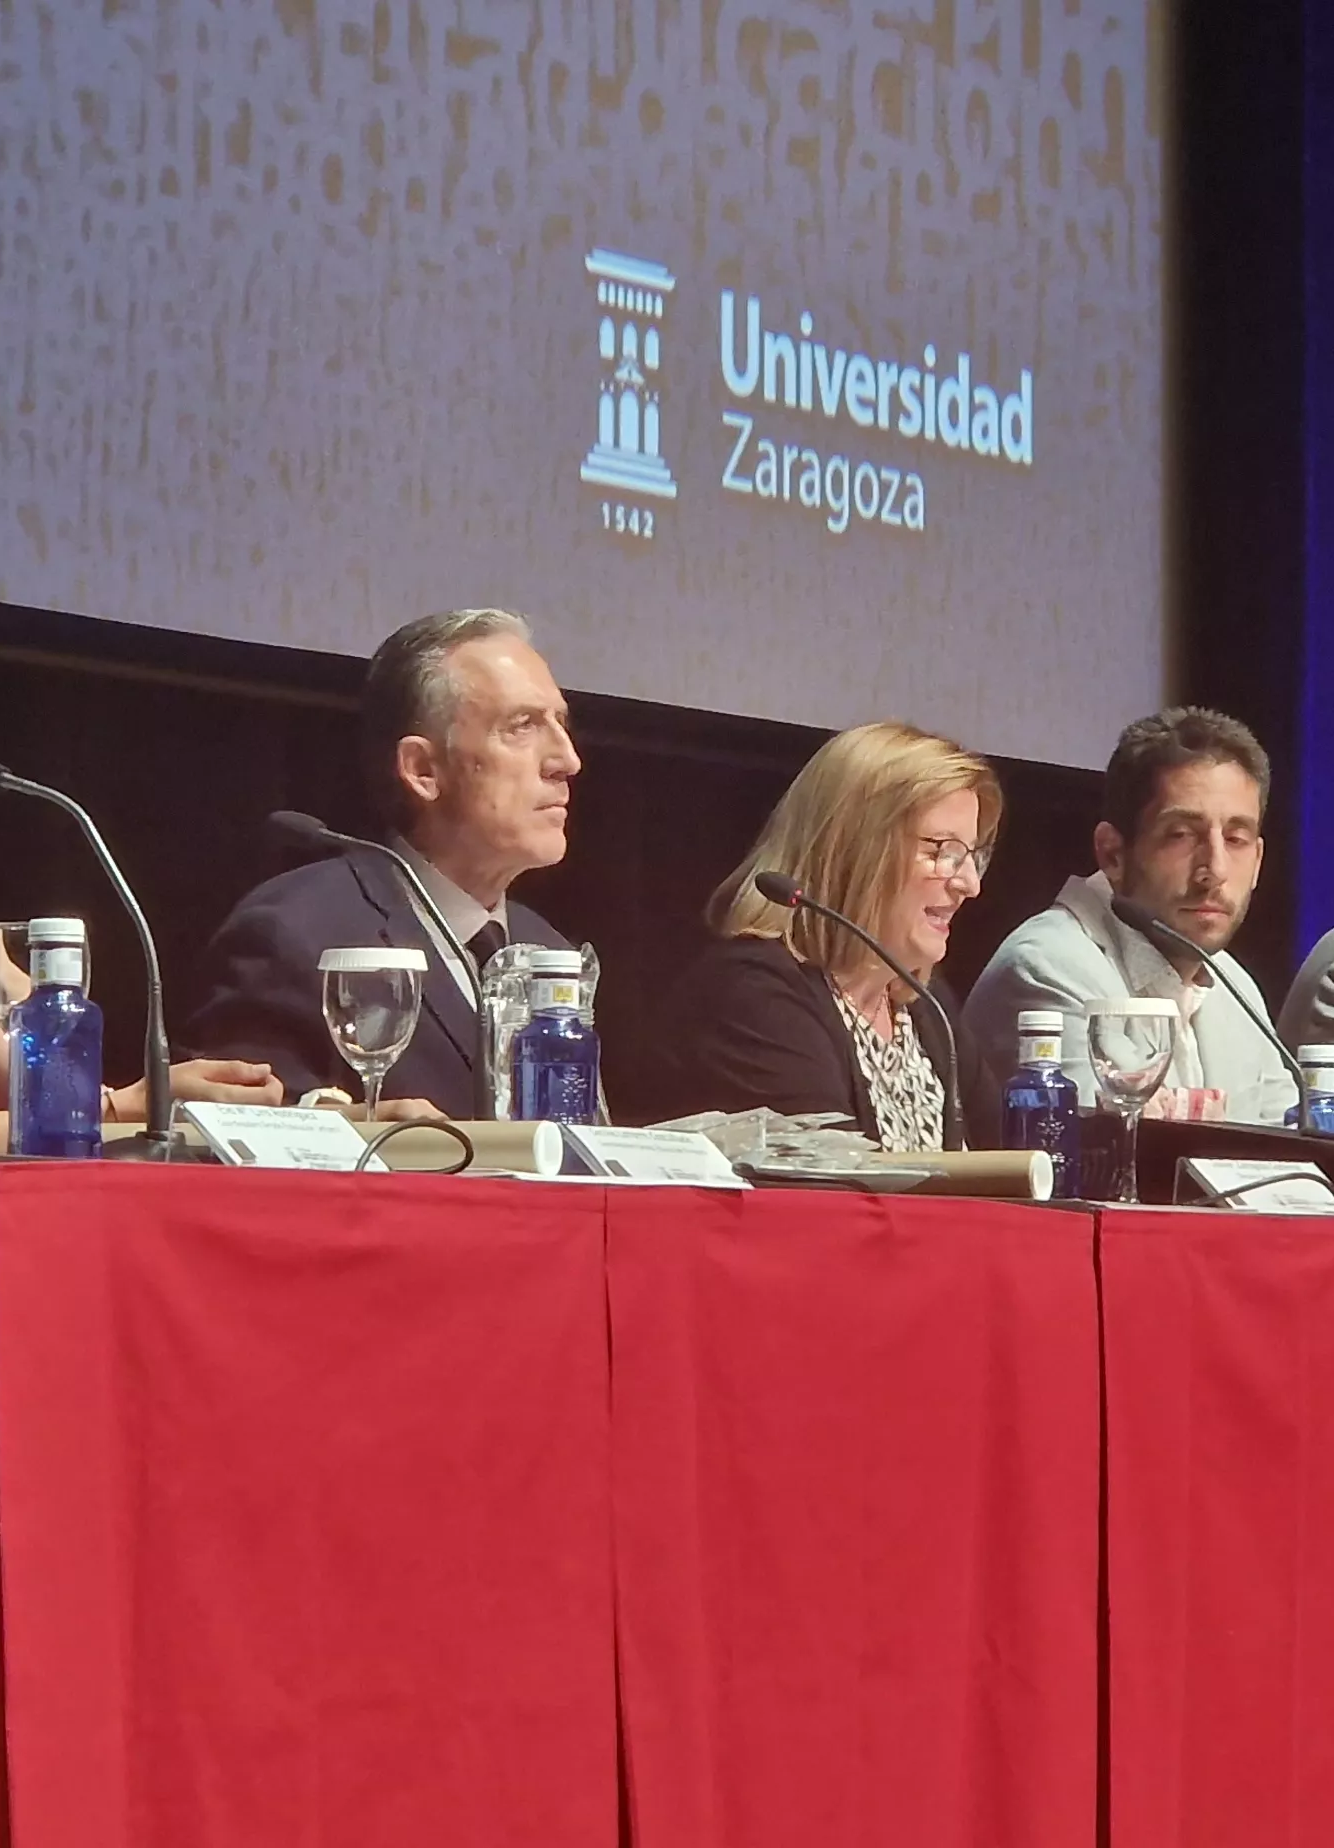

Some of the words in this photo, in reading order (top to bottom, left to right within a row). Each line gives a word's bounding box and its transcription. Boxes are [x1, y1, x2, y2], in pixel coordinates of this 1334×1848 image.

[720, 287, 1033, 465] Universidad
[601, 502, 654, 538] 1542
[721, 408, 925, 533] Zaragoza
